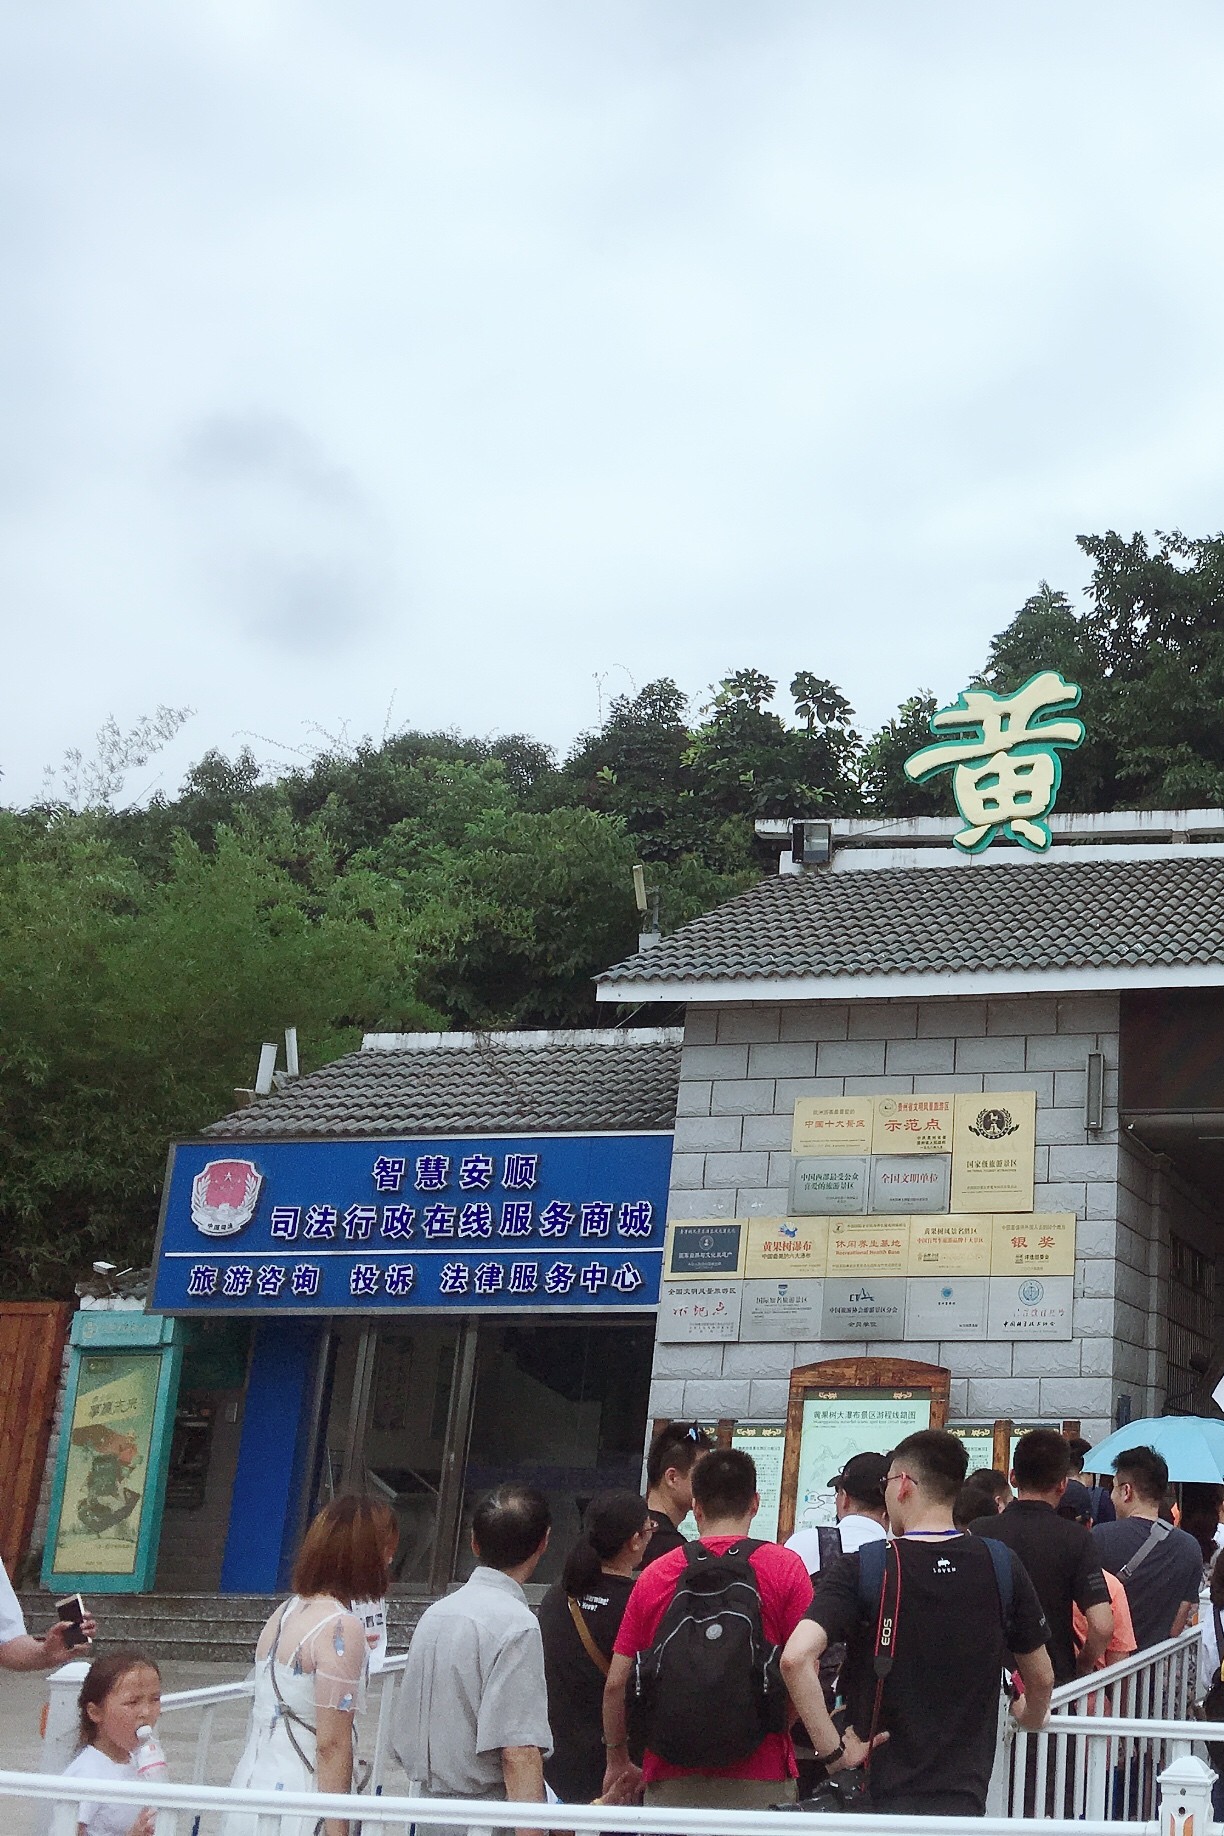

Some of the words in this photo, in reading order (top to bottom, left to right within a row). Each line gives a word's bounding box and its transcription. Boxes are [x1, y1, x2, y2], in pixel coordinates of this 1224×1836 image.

[805, 1120, 865, 1129] 中国十大景区
[884, 1118, 942, 1132] 示范点
[967, 1160, 1017, 1169] 国家级旅游景区
[373, 1154, 538, 1191] 智慧安顺
[801, 1173, 859, 1182] 中国西部最受公众
[881, 1173, 938, 1184] 全国文明单位
[271, 1201, 653, 1239] 司法行政在线服务商城
[924, 1227, 977, 1235] 黄果树风景名胜区
[763, 1241, 812, 1251] 黄果树瀑布
[835, 1240, 901, 1248] 休闲养生基地
[1011, 1236, 1056, 1248] 银奖
[188, 1264, 320, 1296] 旅游咨询
[351, 1264, 414, 1295] 投诉
[441, 1262, 643, 1293] 法律服务中心
[668, 1288, 737, 1296] 全国文明风景旅游区
[881, 1618, 892, 1646] EOS
